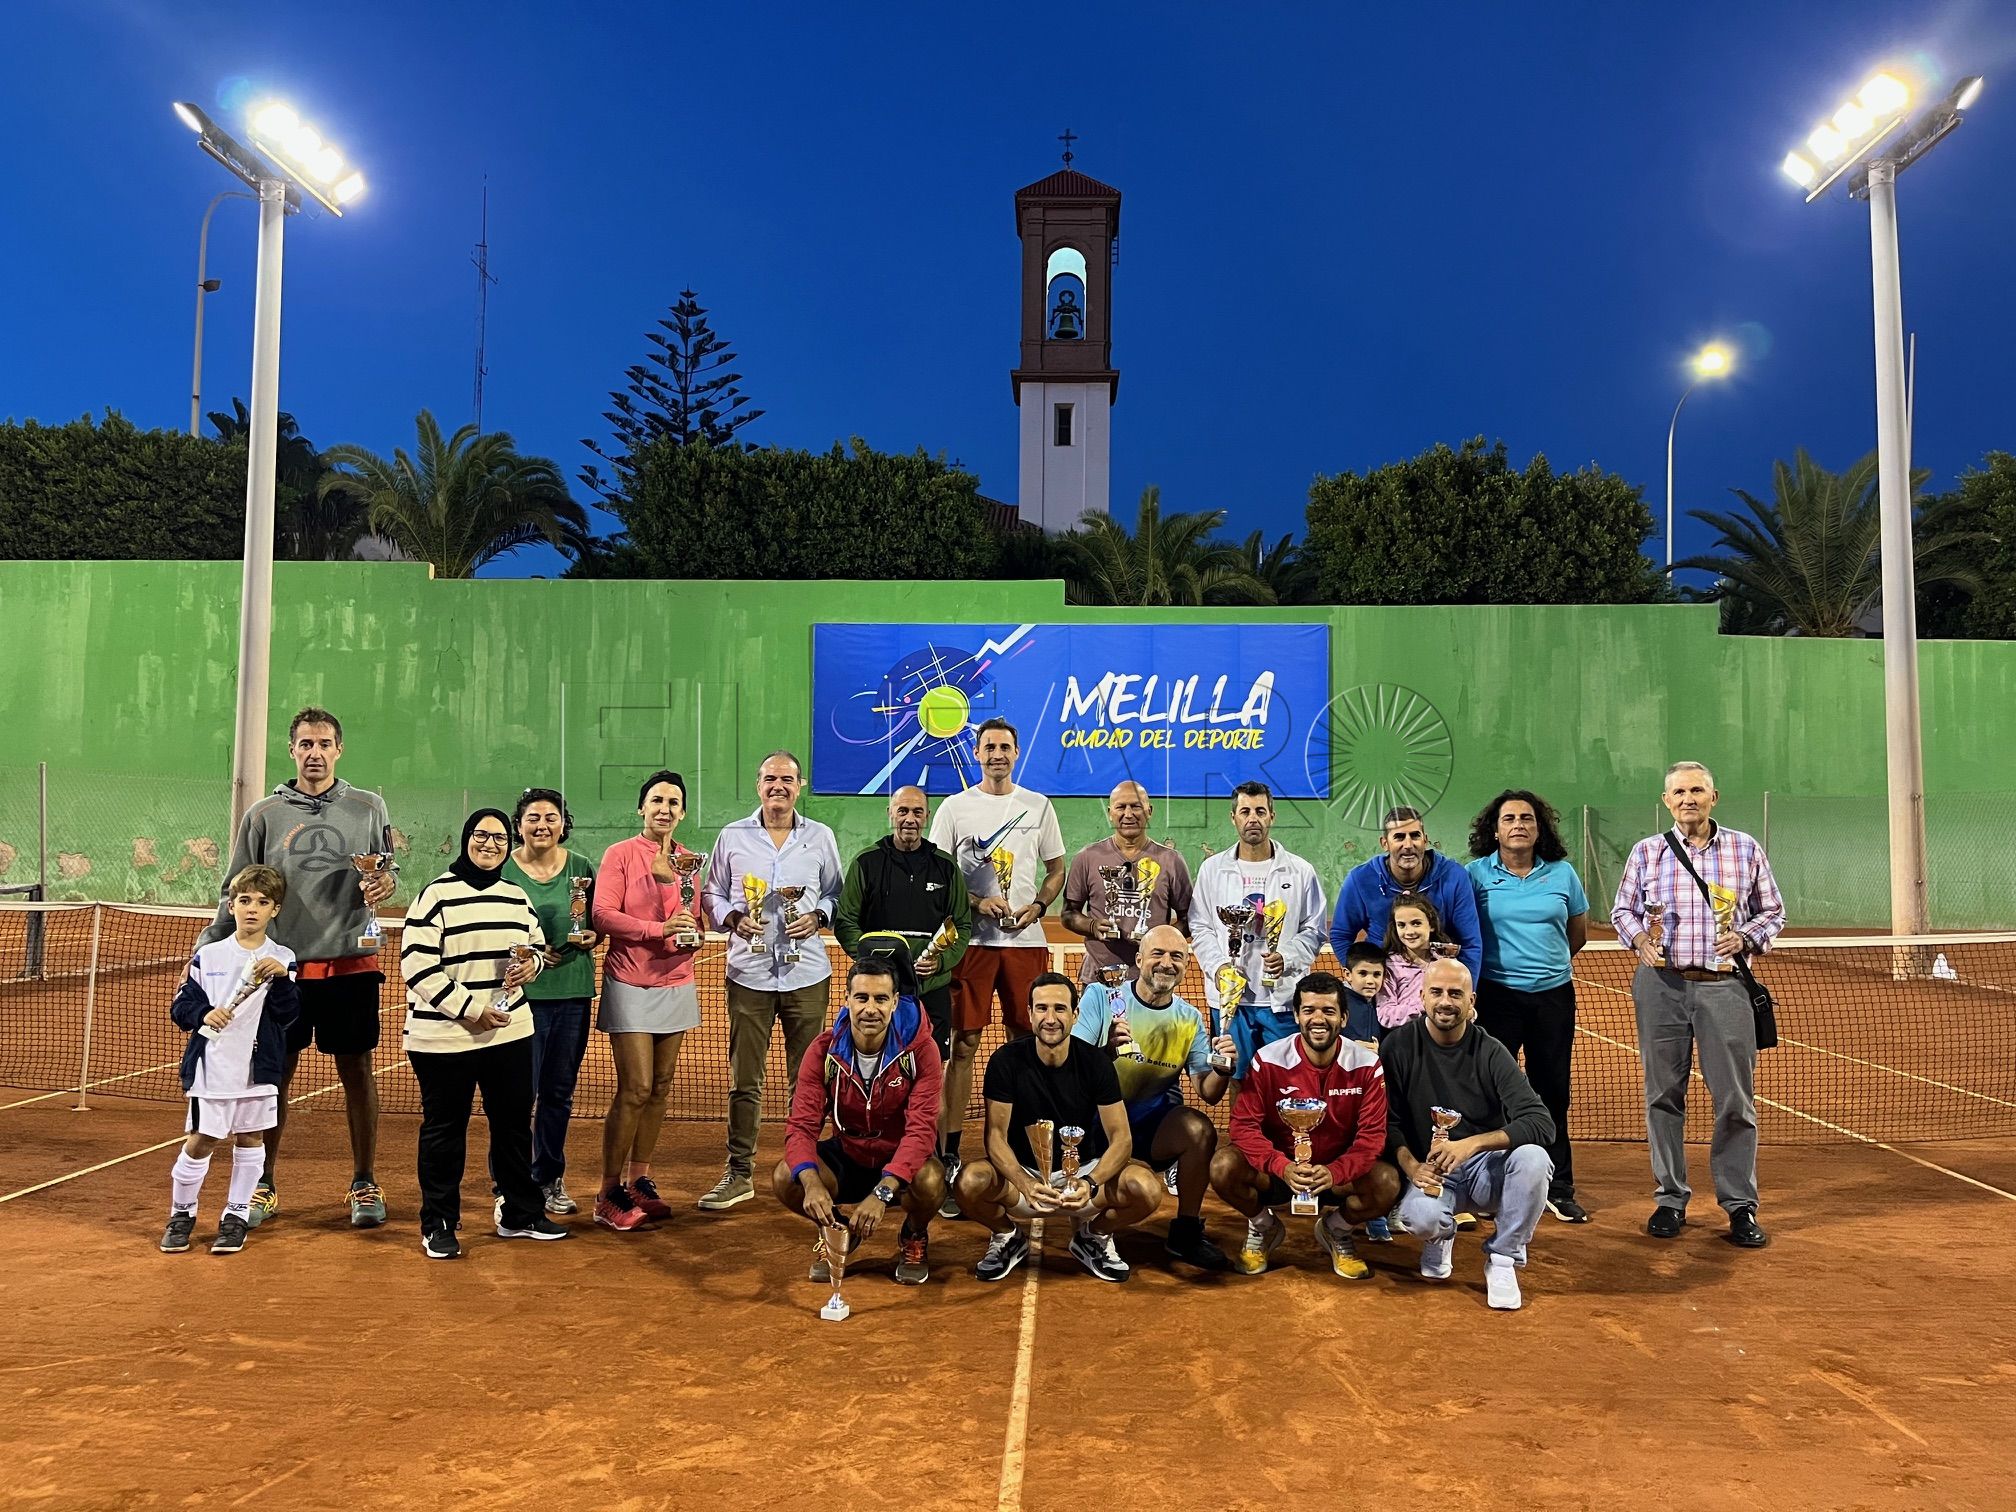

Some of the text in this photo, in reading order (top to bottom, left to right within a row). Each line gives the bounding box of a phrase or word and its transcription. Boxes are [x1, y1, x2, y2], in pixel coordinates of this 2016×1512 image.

[1060, 670, 1275, 727] MELILLA
[1060, 728, 1265, 750] CIUDAD DEL DEPORTE
